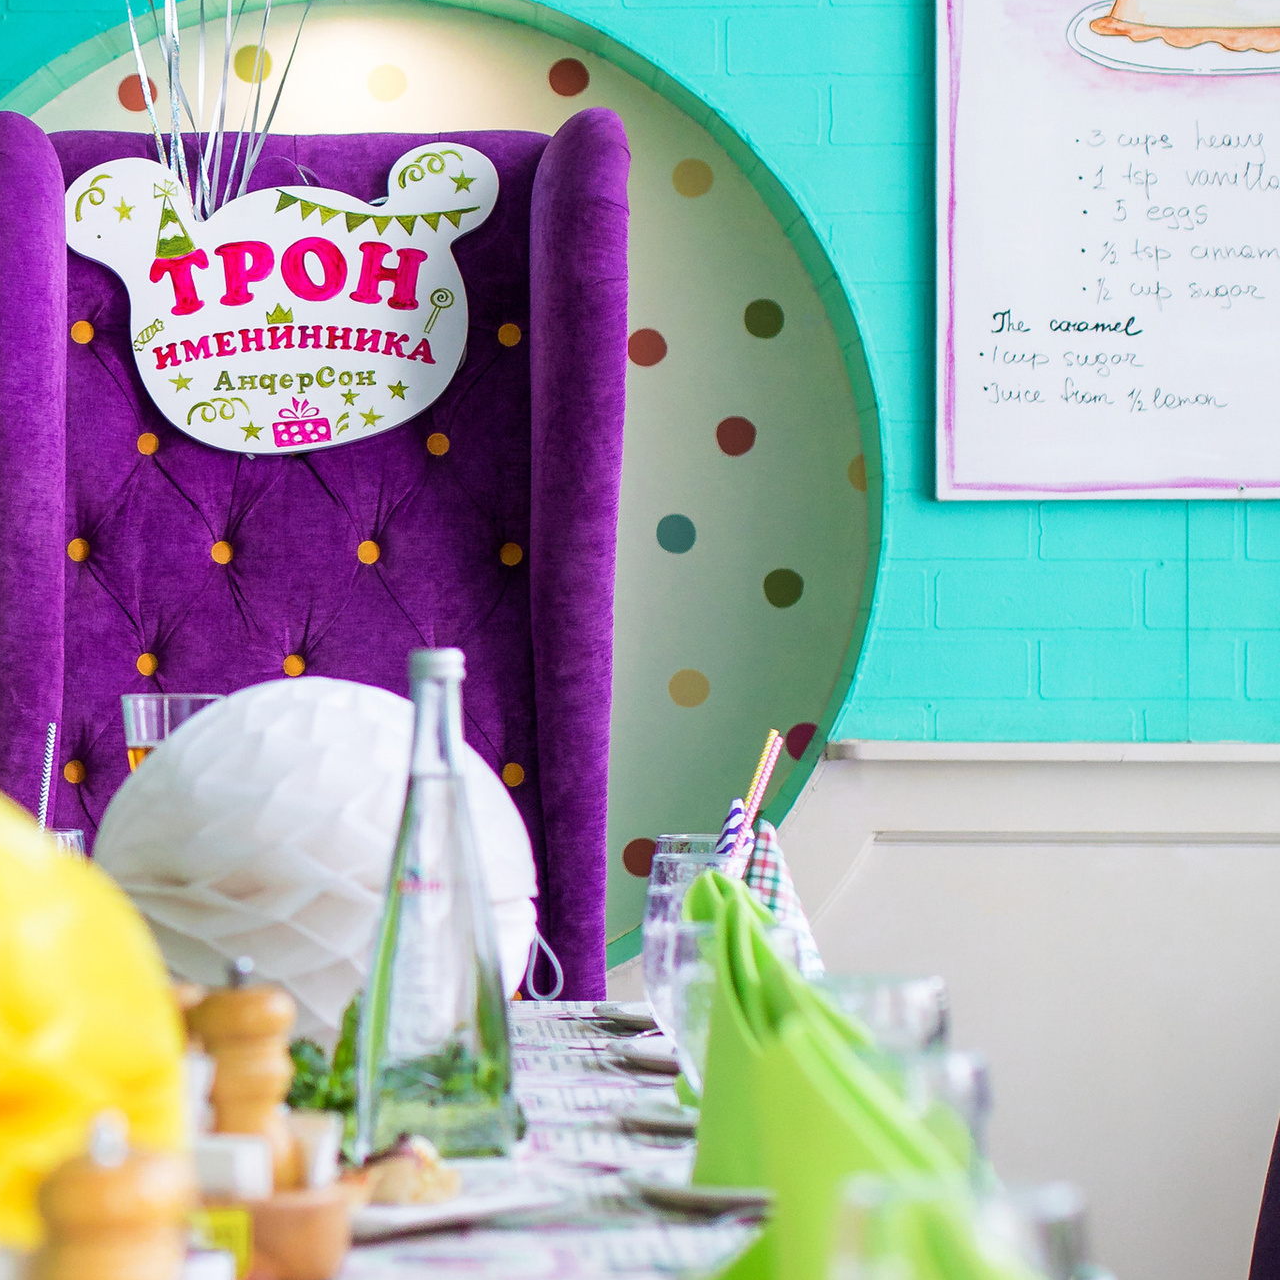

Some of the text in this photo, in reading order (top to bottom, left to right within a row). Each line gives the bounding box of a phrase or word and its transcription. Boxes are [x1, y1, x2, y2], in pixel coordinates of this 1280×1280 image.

[1086, 119, 1267, 165] 3 cups heavy
[1093, 165, 1106, 190] 1
[1122, 162, 1159, 201] tsp
[1112, 198, 1209, 231] 5 eggs
[1131, 238, 1172, 271] tsp
[148, 235, 429, 317] ТРОН
[1129, 281, 1173, 313] cup
[1188, 282, 1266, 310] sugar
[991, 309, 1144, 337] The caramel
[152, 323, 437, 371] ИМЕНИННИКА
[1062, 351, 1144, 378] sugar
[987, 382, 1046, 405] Juice
[1060, 377, 1115, 406] from
[1152, 387, 1229, 409] lemon
